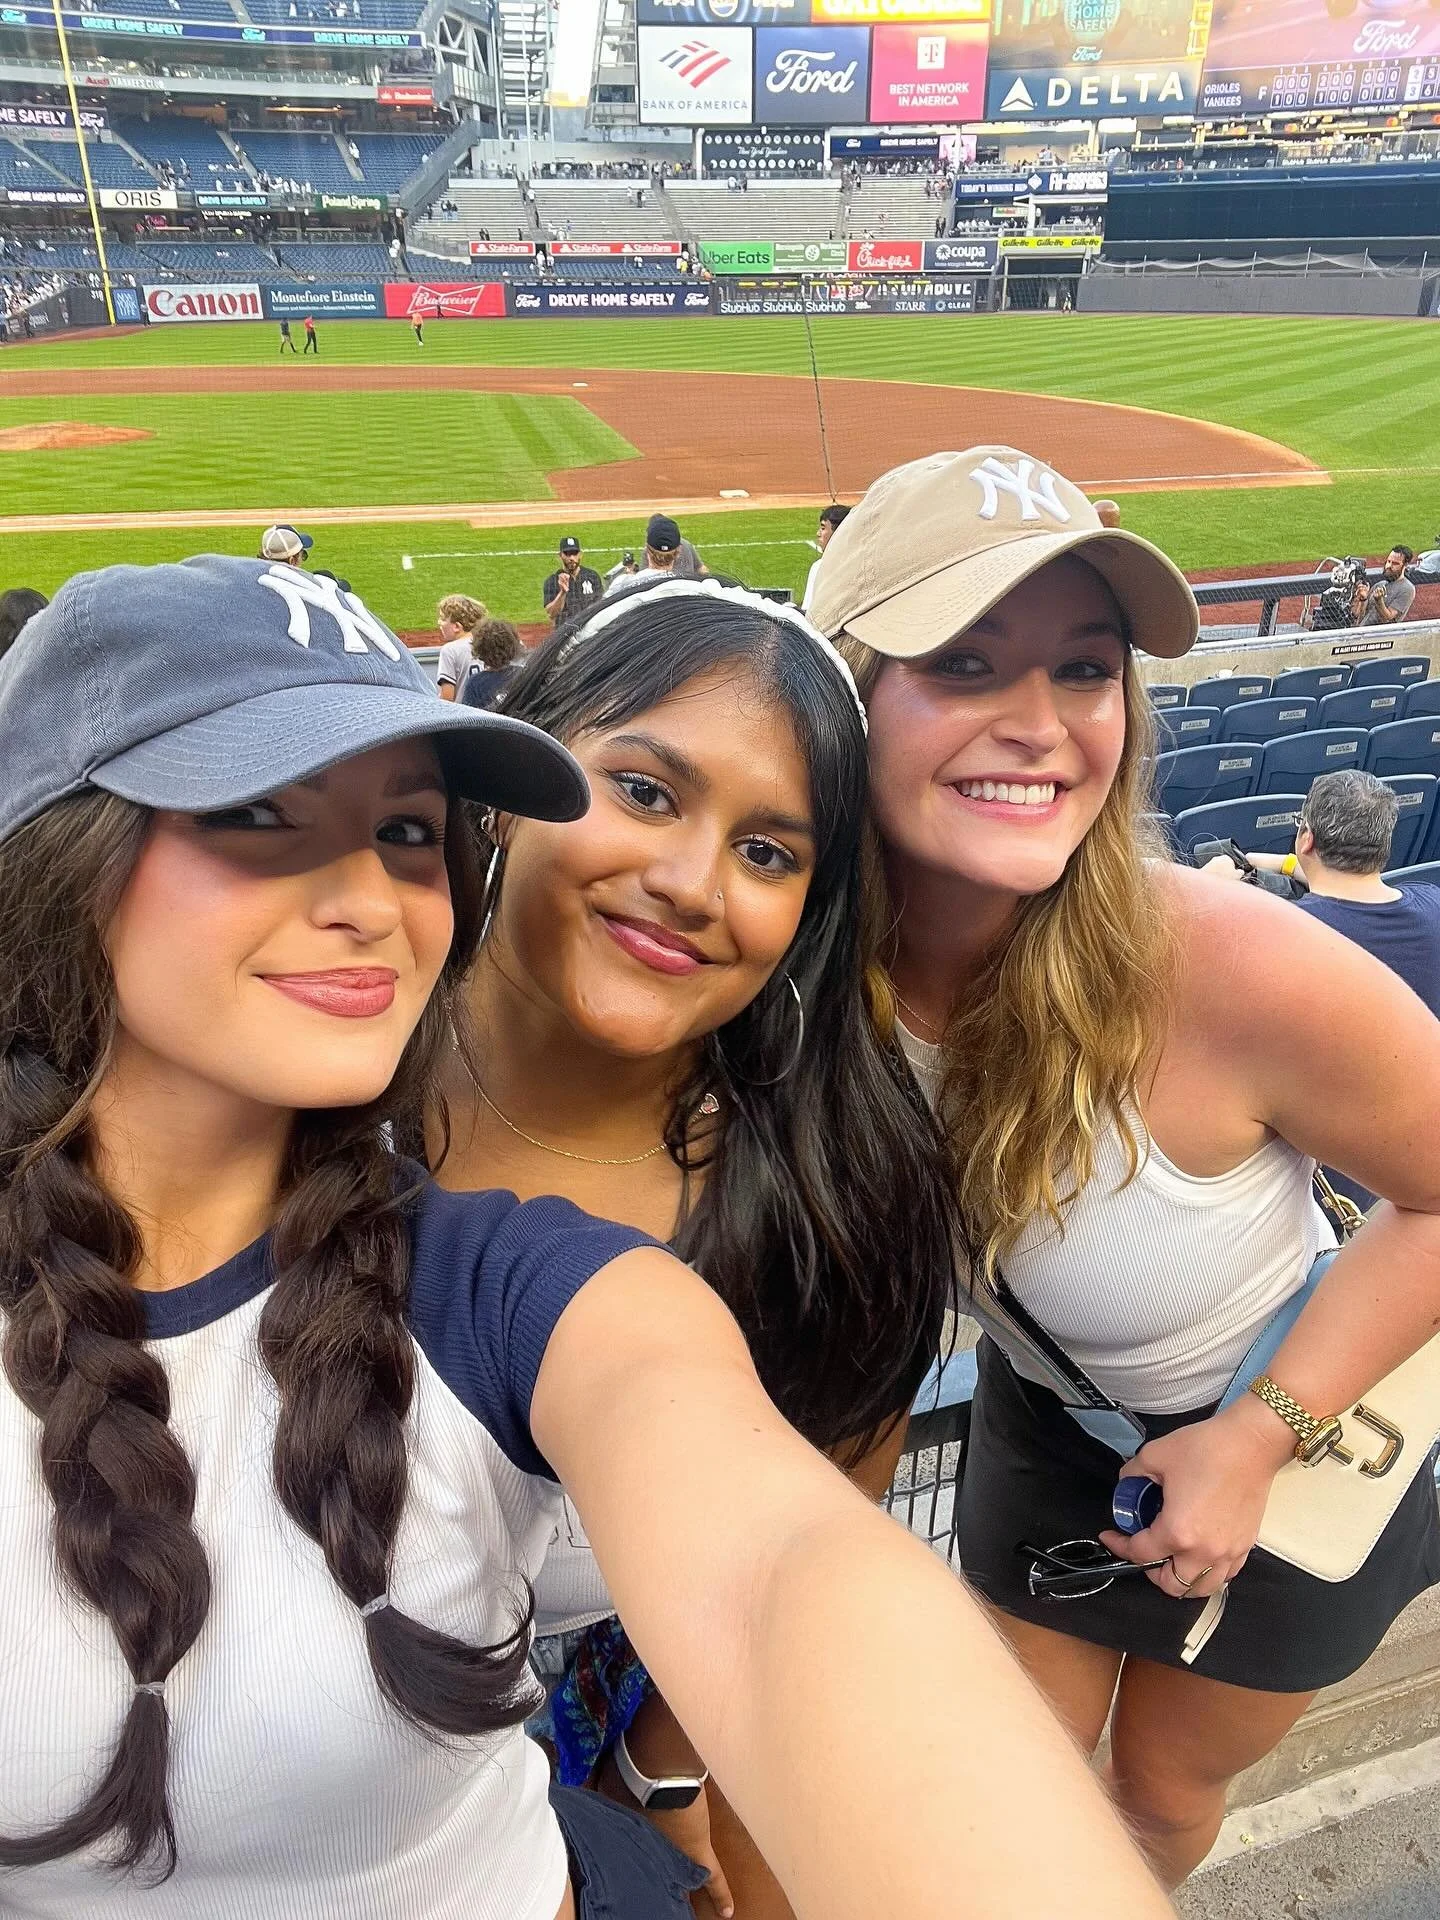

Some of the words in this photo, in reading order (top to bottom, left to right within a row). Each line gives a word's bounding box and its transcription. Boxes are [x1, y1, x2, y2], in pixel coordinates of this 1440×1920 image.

[1353, 20, 1421, 54] Ford
[1072, 46, 1103, 61] Ford
[766, 49, 858, 93] Ford
[889, 83, 915, 95] BEST
[916, 82, 969, 94] NETWORK
[1047, 71, 1184, 107] DELTA
[1205, 83, 1240, 94] ORIOLES
[642, 100, 675, 109] BANK
[678, 100, 692, 109] OF
[695, 100, 748, 109] AMERICA
[898, 96, 910, 106] IN
[911, 95, 959, 106] AMERICA
[1204, 96, 1242, 107] YANKEES
[19, 109, 67, 125] SAFELY
[115, 191, 162, 207] ORIS
[321, 195, 350, 208] Poland
[350, 195, 381, 211] Spring
[1002, 239, 1029, 247] Gillette
[1036, 239, 1064, 247] Gillette
[1071, 238, 1099, 246] Gillette
[702, 251, 734, 264] Uber
[738, 251, 770, 264] Eats
[951, 246, 986, 260] coupa
[148, 290, 259, 316] Canon
[271, 290, 330, 303] Montefiore
[331, 290, 375, 303] Einstein
[413, 291, 478, 307] Budweiser
[515, 294, 541, 308] Ford
[548, 293, 589, 307] DRIVE
[591, 293, 628, 307] HOME
[630, 293, 675, 306] SAFELY
[684, 292, 710, 306] Ford
[720, 302, 760, 313] StubHub
[763, 301, 803, 312] StubHub
[806, 301, 846, 312] StubHub
[895, 301, 926, 311] STARR
[947, 302, 970, 310] CLEAR
[969, 457, 1071, 523] NY
[257, 564, 401, 662] NY
